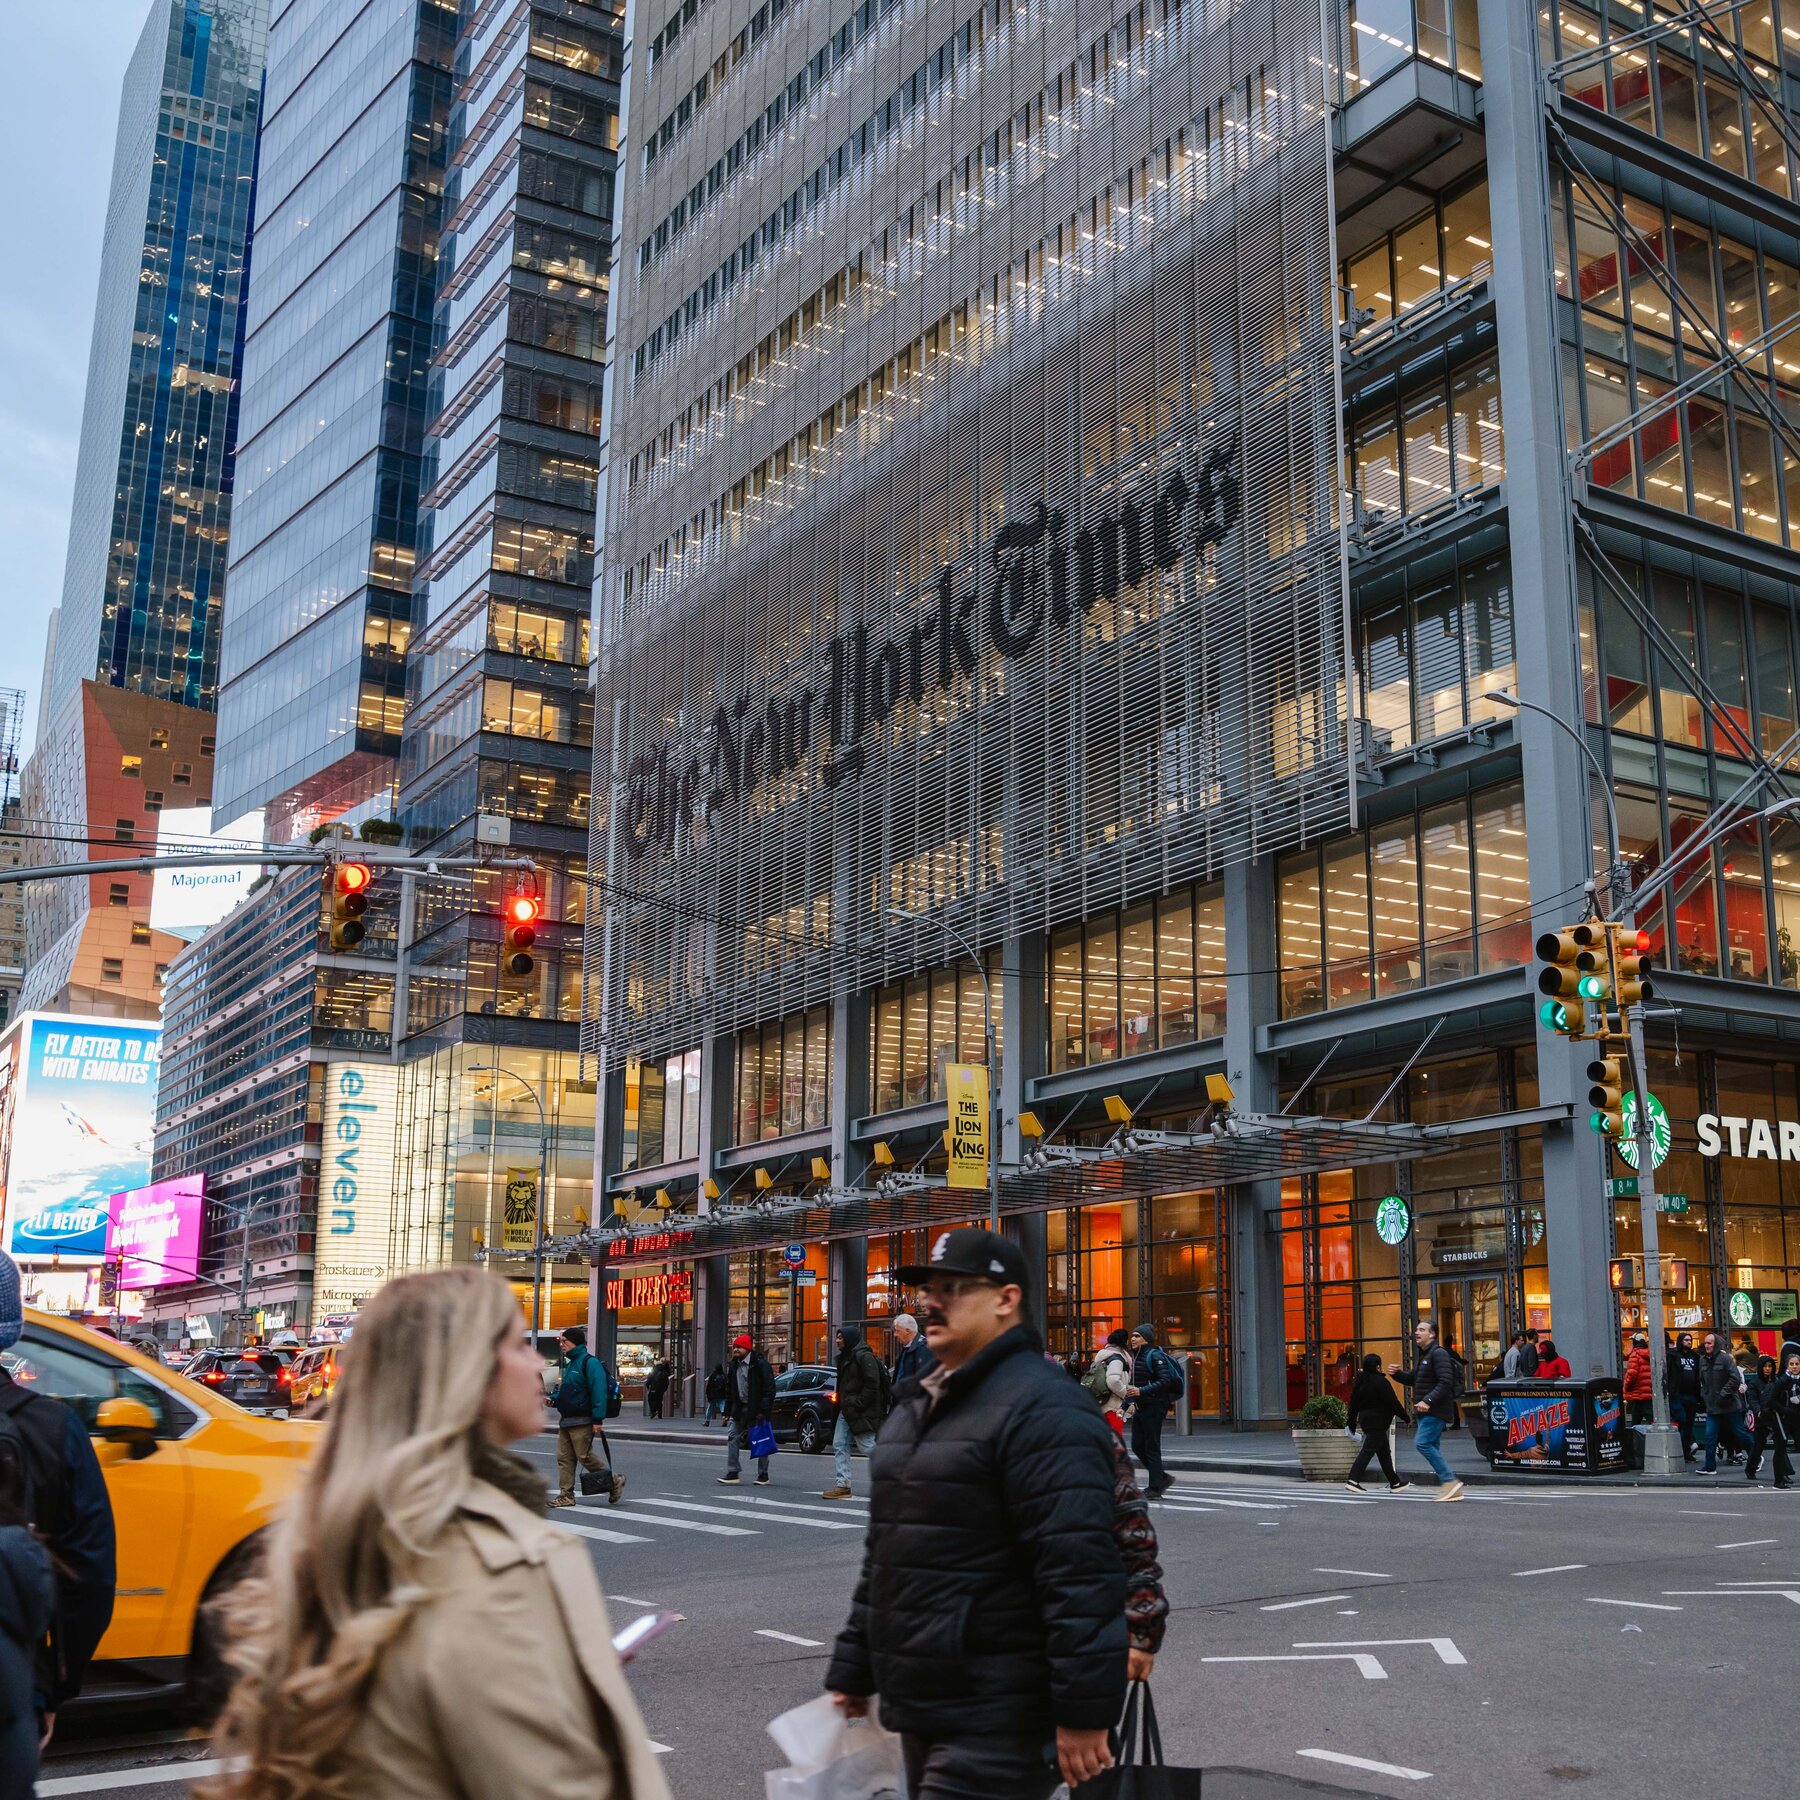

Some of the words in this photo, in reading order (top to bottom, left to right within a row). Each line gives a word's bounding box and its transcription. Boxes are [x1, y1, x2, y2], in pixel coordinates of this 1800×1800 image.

[822, 563, 979, 789] York
[989, 428, 1242, 660] Times
[44, 1033, 70, 1054] FLY
[70, 1035, 121, 1059] BETTER
[123, 1040, 142, 1061] TO
[42, 1056, 80, 1079] WITH
[81, 1059, 150, 1084] EMIRATES
[958, 1101, 978, 1113] THE
[955, 1117, 981, 1136] LION
[1697, 1113, 1800, 1162] STAR
[331, 1070, 378, 1235] eleven
[952, 1137, 984, 1159] KING
[1618, 1180, 1624, 1193] 8
[1626, 1180, 1633, 1188] Av
[1663, 1196, 1670, 1209] W
[1671, 1196, 1680, 1210] 40
[1681, 1196, 1686, 1205] St
[28, 1211, 52, 1230] FLY
[52, 1212, 98, 1231] BETTER
[510, 1235, 533, 1243] MUSICAL
[1442, 1251, 1488, 1262] STARBUCKS
[320, 1263, 374, 1276] Proskauer
[322, 1289, 372, 1300] Microsoft
[607, 1275, 668, 1310] SCHIPPER'S
[1680, 1358, 1695, 1366] NYC
[1507, 1400, 1571, 1447] AMAZE
